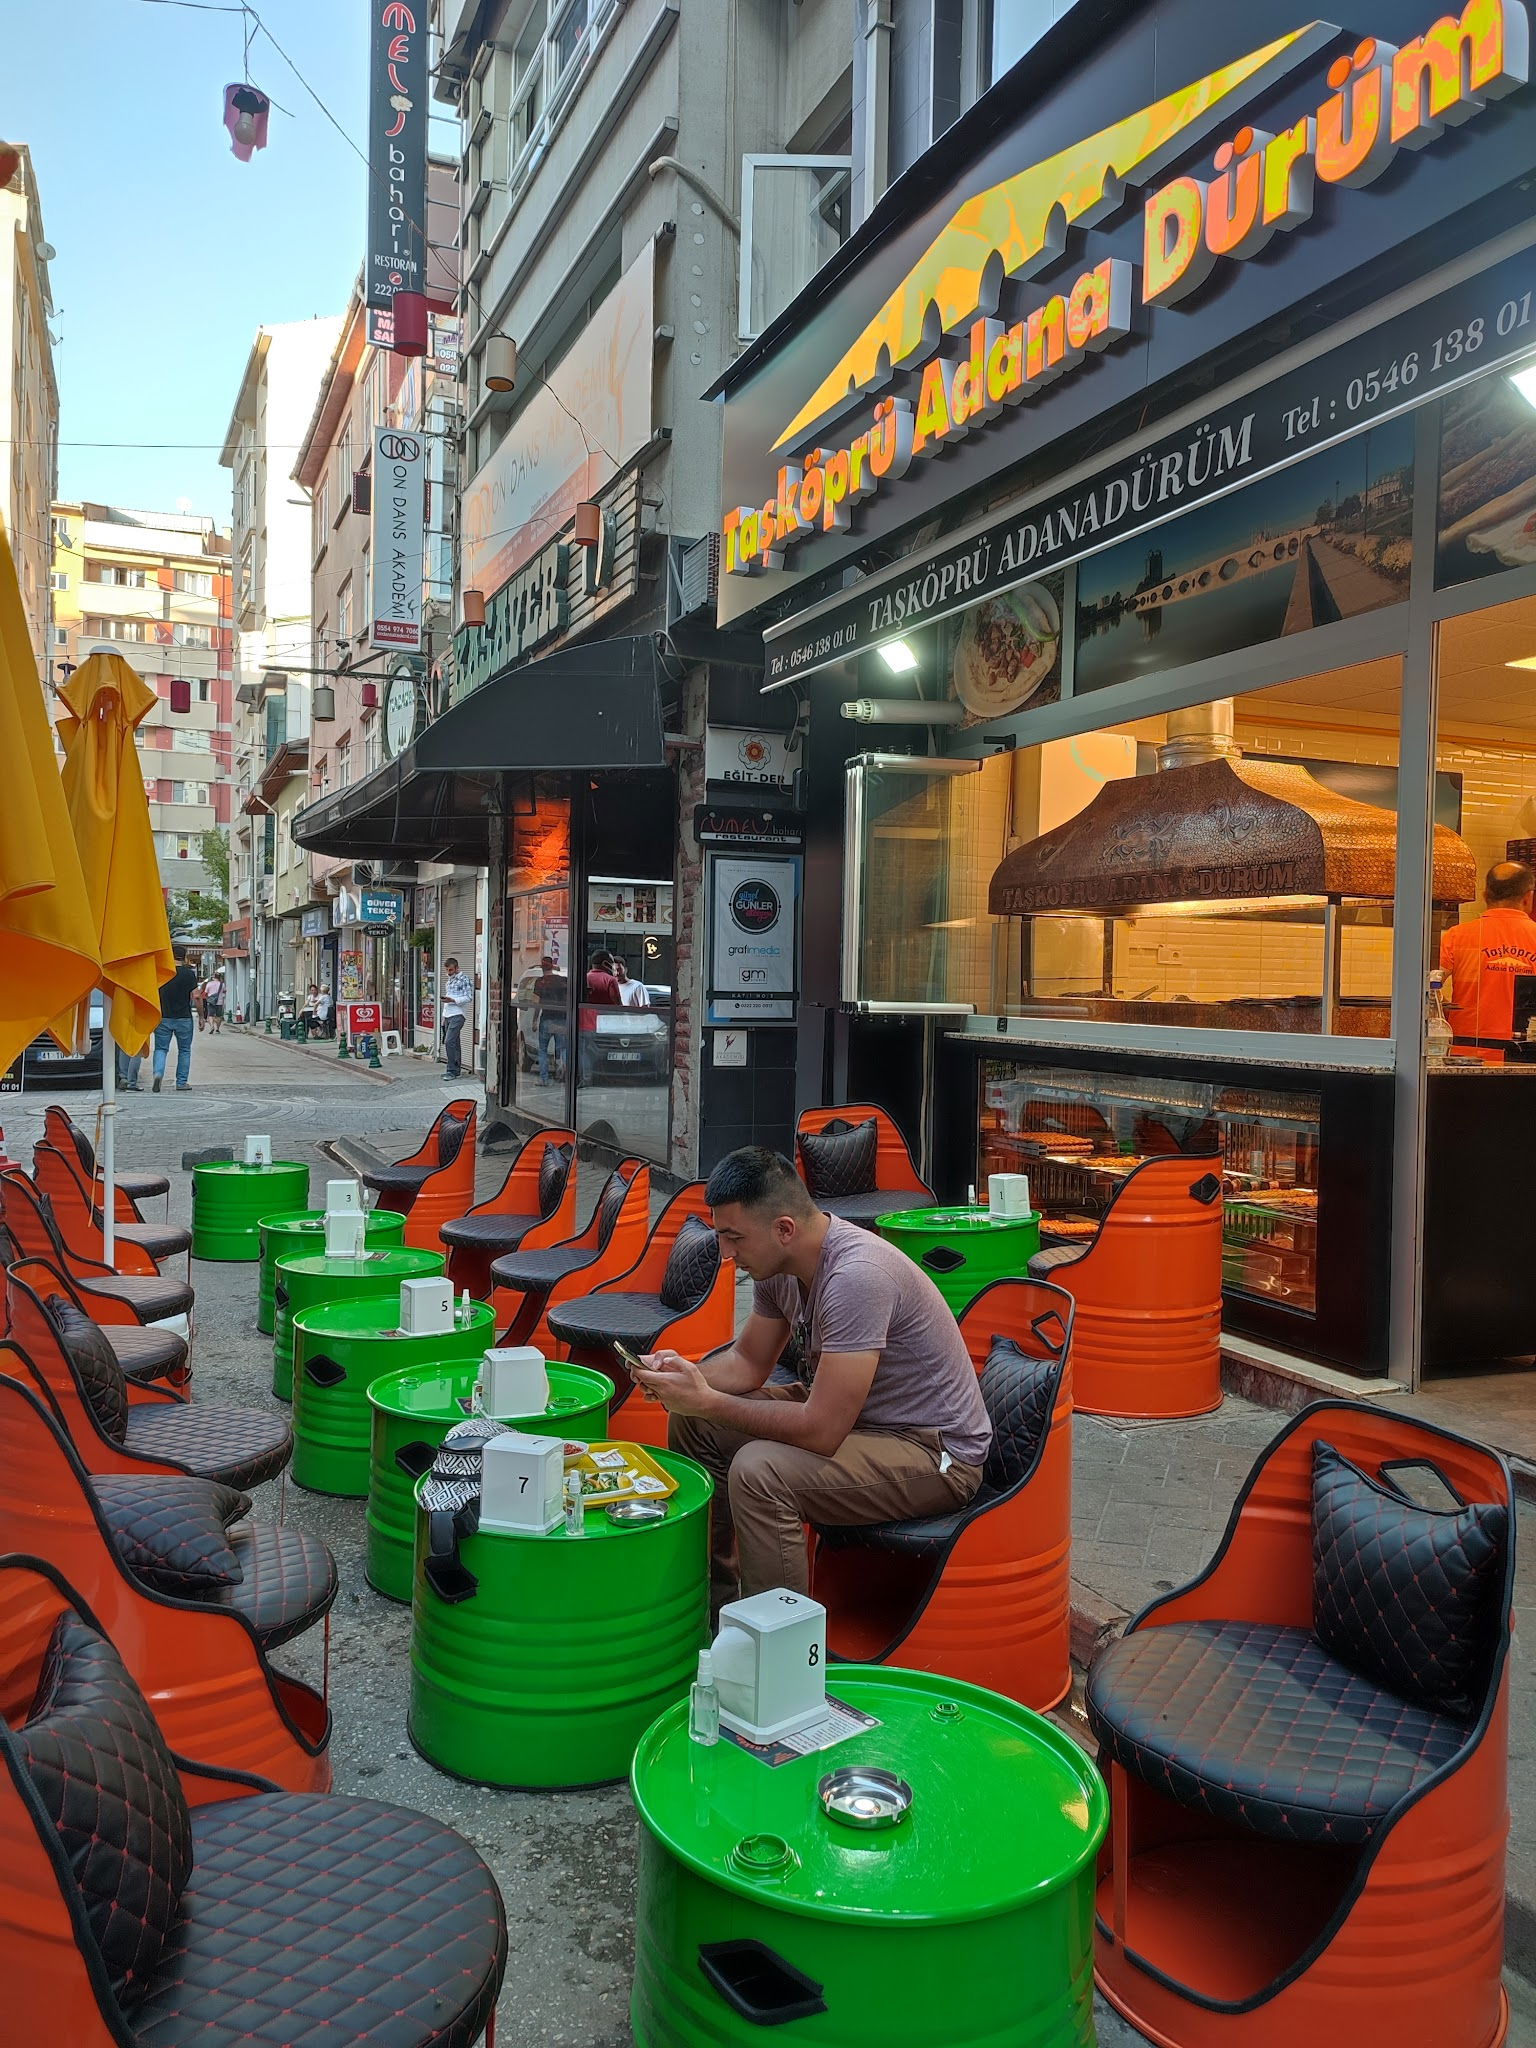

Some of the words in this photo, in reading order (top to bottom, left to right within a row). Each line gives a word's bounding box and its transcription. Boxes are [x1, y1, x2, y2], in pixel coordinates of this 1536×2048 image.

[724, 396, 898, 574] Taşköprü
[911, 257, 1113, 455] Adana
[1142, 0, 1504, 304] Dürüm
[393, 465, 407, 490] ON
[770, 656, 784, 676] Tel
[789, 643, 814, 669] 0546
[813, 634, 832, 658] 138
[833, 630, 844, 649] 01
[845, 622, 857, 641] 01
[868, 536, 992, 633] TAŞKÖPRÜ
[996, 413, 1256, 576] ADANADÜRÜM
[1281, 396, 1320, 442] Tel
[1345, 352, 1419, 411] 0546
[1430, 317, 1486, 373] 138
[1496, 291, 1532, 337] 01
[392, 497, 407, 540] DANS
[723, 769, 785, 784] EĞİT-DER
[1198, 861, 1296, 895] DÜRÜM
[741, 969, 766, 982] gm
[346, 1194, 351, 1202] 3
[441, 1300, 449, 1312] 5
[518, 1476, 529, 1494] 7
[808, 1643, 819, 1667] 8
